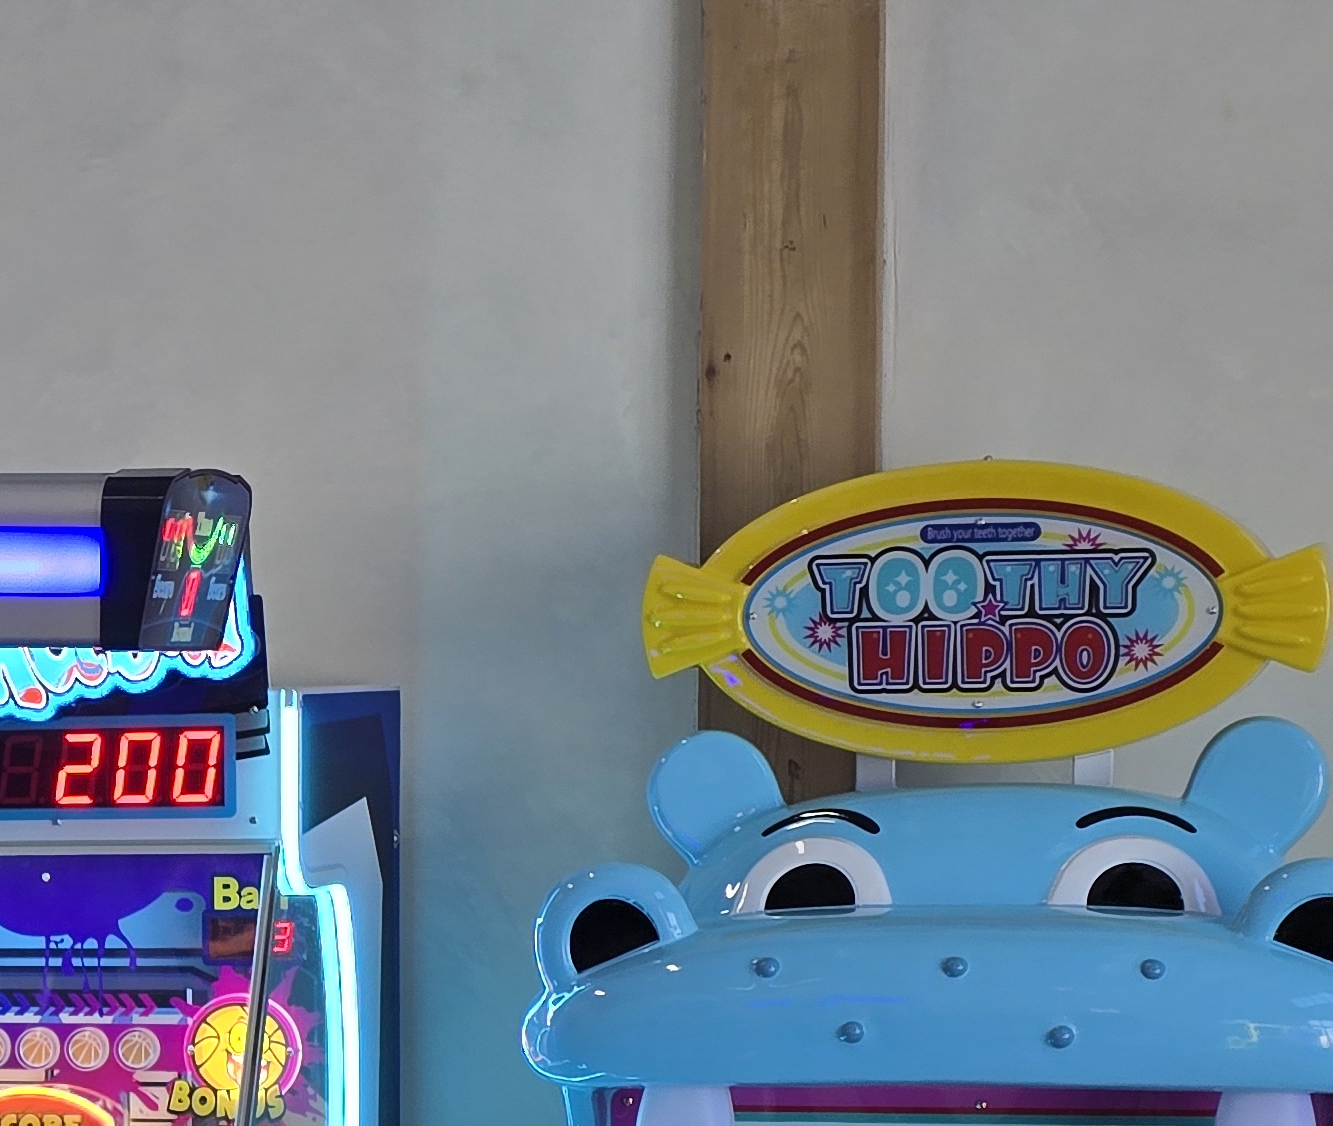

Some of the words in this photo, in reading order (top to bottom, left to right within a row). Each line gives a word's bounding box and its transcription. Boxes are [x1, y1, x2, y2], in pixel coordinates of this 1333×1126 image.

[927, 527, 951, 540] Brush
[953, 528, 972, 541] your
[974, 526, 996, 539] teeth
[998, 525, 1035, 541] together
[811, 547, 1154, 620] TOOTHY
[851, 618, 1118, 690] HIPPO
[54, 731, 222, 806] 200
